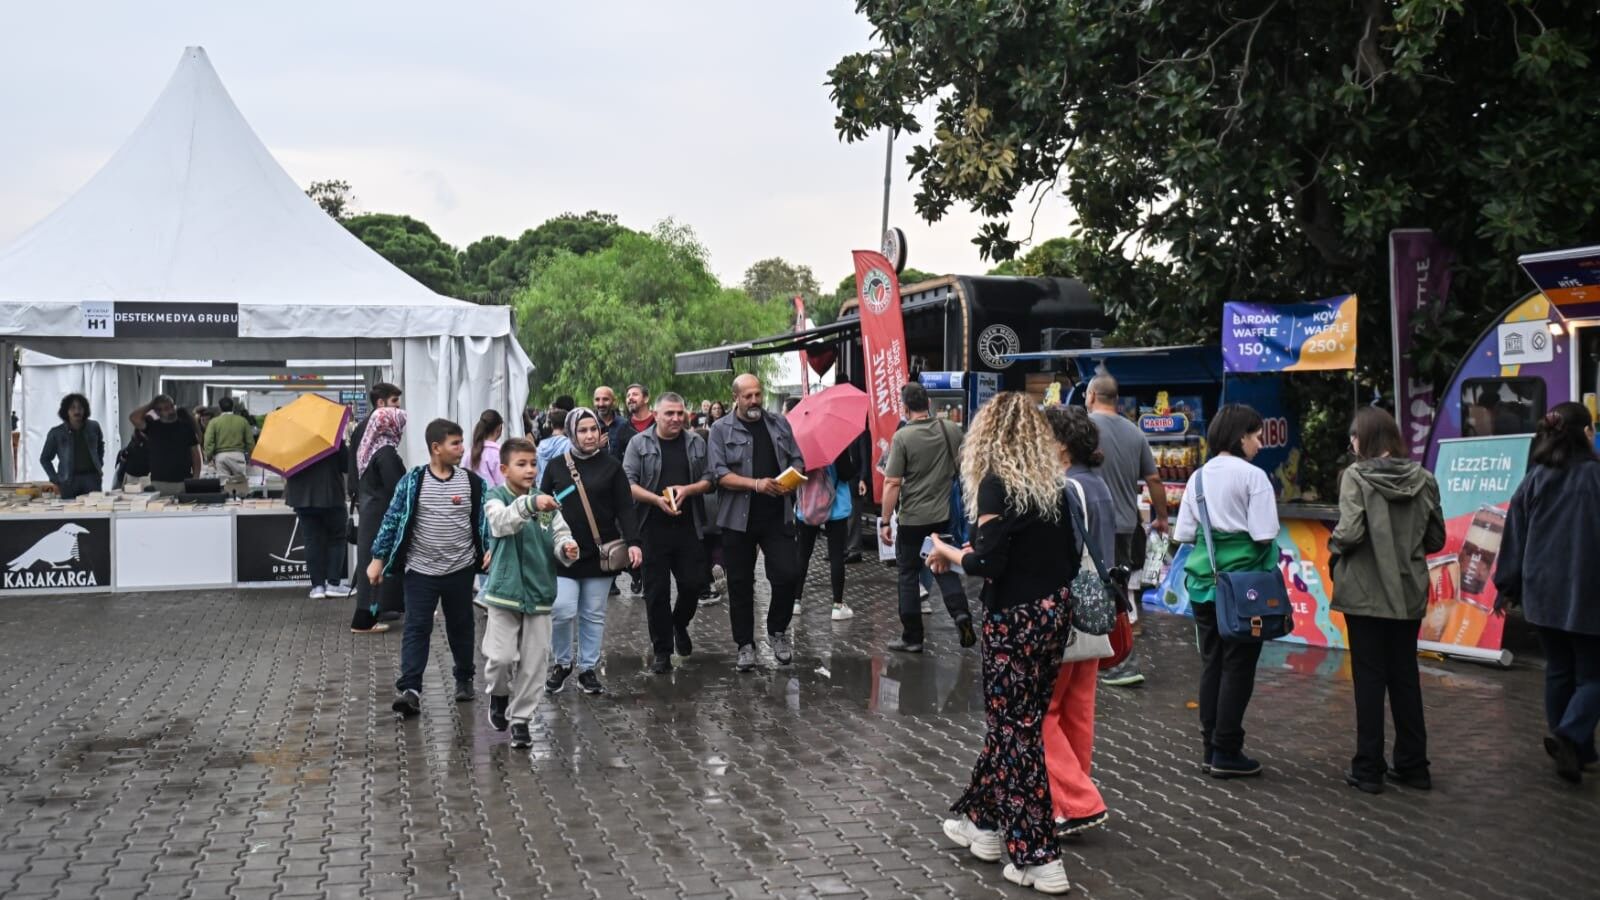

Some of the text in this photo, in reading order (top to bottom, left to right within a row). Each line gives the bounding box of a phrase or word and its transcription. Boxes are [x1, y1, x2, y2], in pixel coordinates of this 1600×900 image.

[114, 312, 238, 324] DESTEK MEDYA GRUBU
[1233, 313, 1281, 326] BARDAK
[1312, 309, 1343, 323] KOVA
[88, 318, 107, 330] H1
[1304, 322, 1349, 336] WAFFLE
[1233, 327, 1278, 338] WAFFLE
[1143, 418, 1174, 429] HARIBO
[1450, 452, 1512, 472] LEZZETİN
[1447, 473, 1512, 492] YENİ HALİ
[4, 570, 98, 589] KARAKARGA
